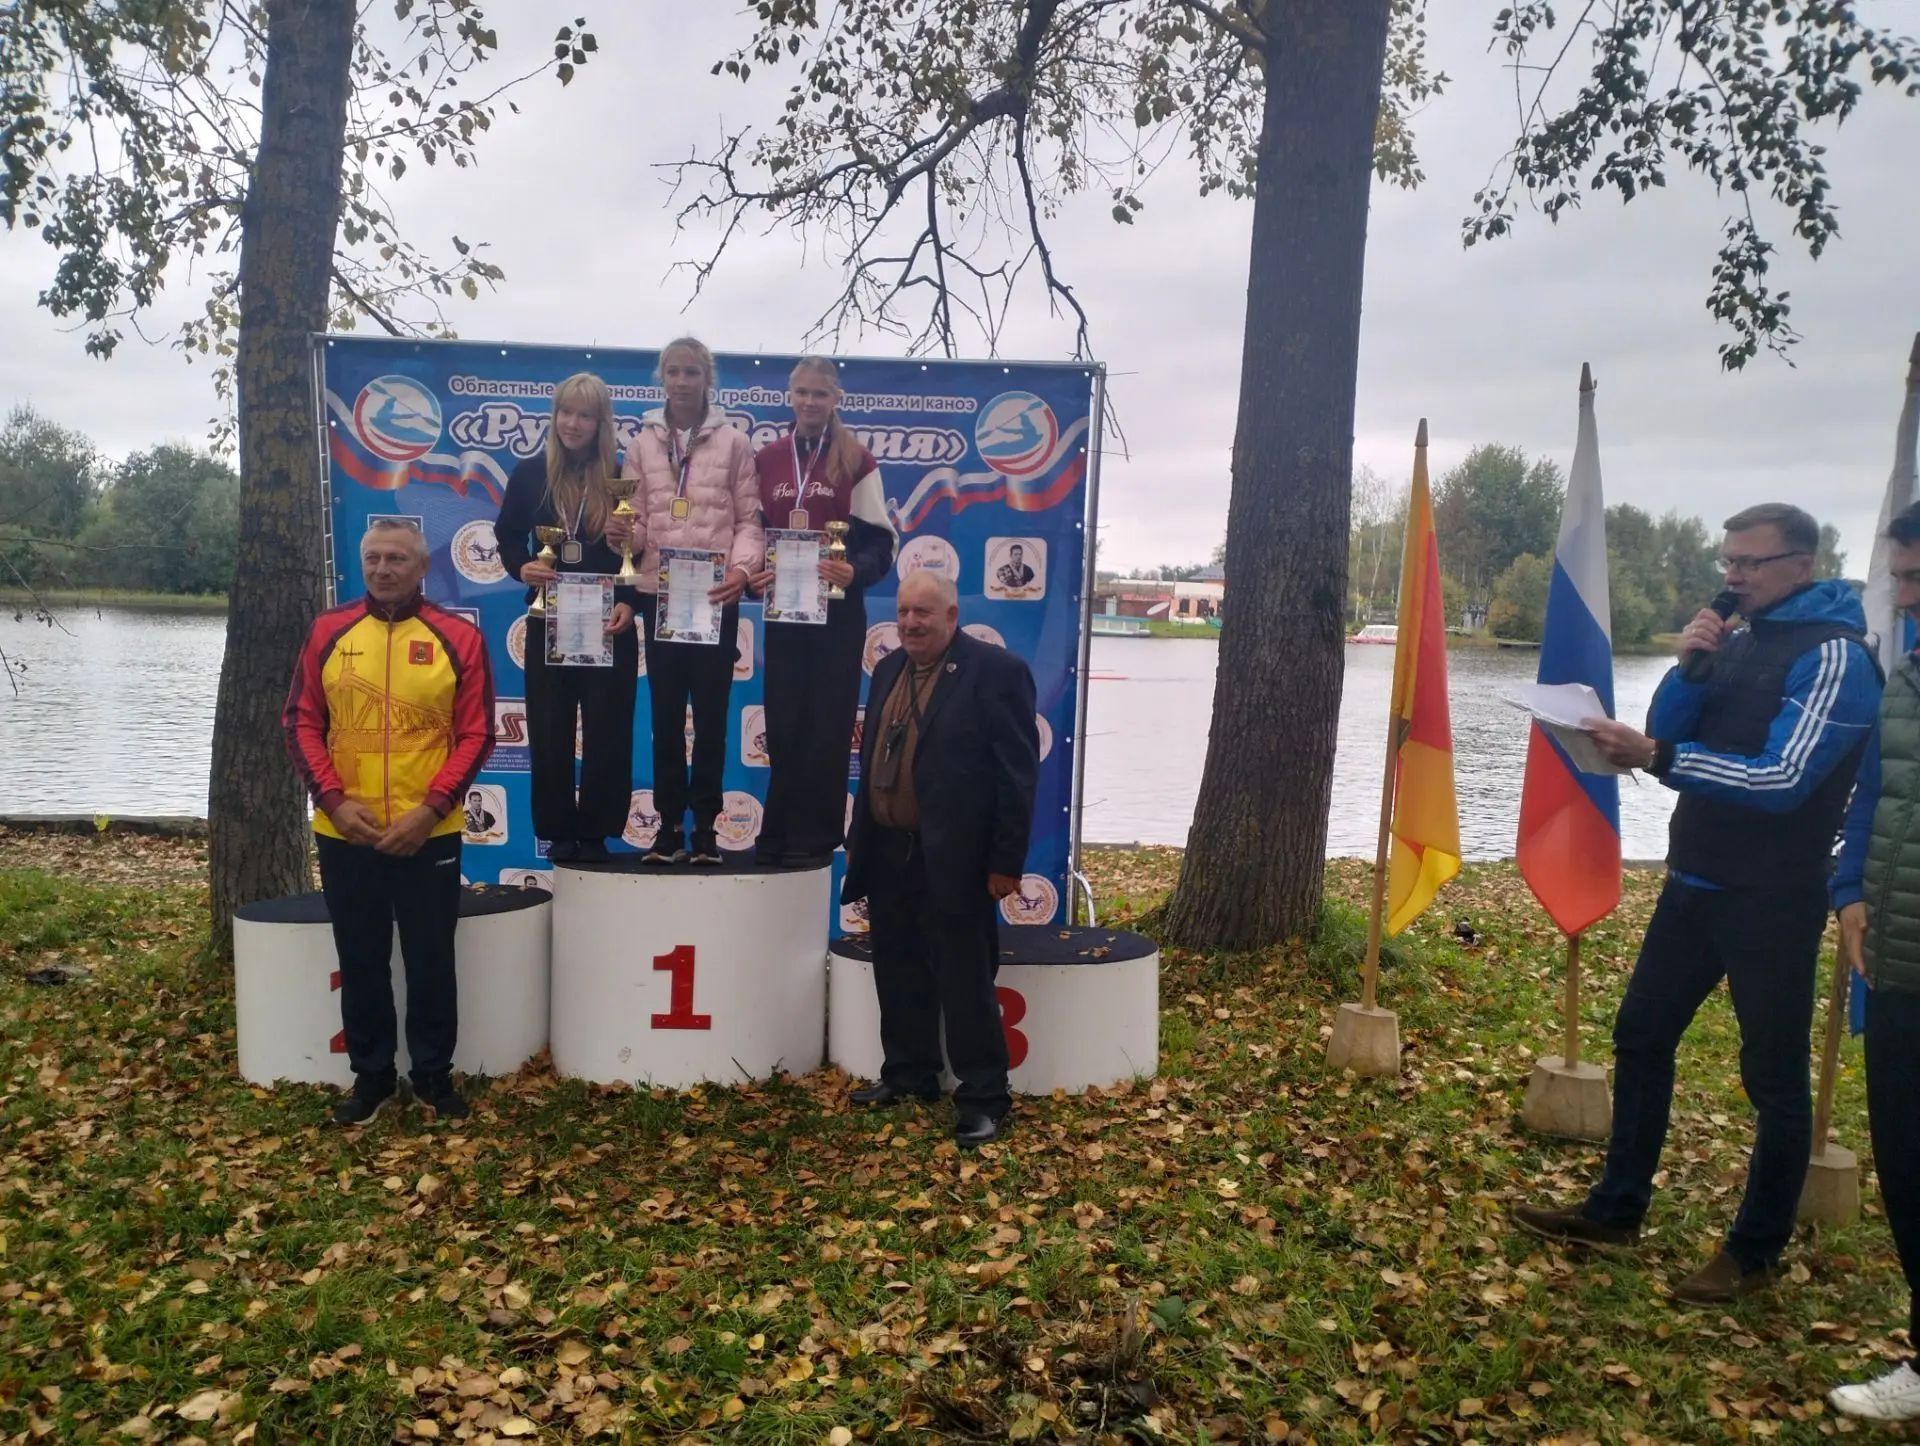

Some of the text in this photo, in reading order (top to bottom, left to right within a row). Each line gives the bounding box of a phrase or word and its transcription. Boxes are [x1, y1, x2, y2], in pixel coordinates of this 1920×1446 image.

[450, 377, 555, 396] Областные
[721, 387, 782, 406] гребле
[910, 397, 920, 409] и
[926, 397, 976, 411] каноэ
[651, 944, 711, 1030] 1
